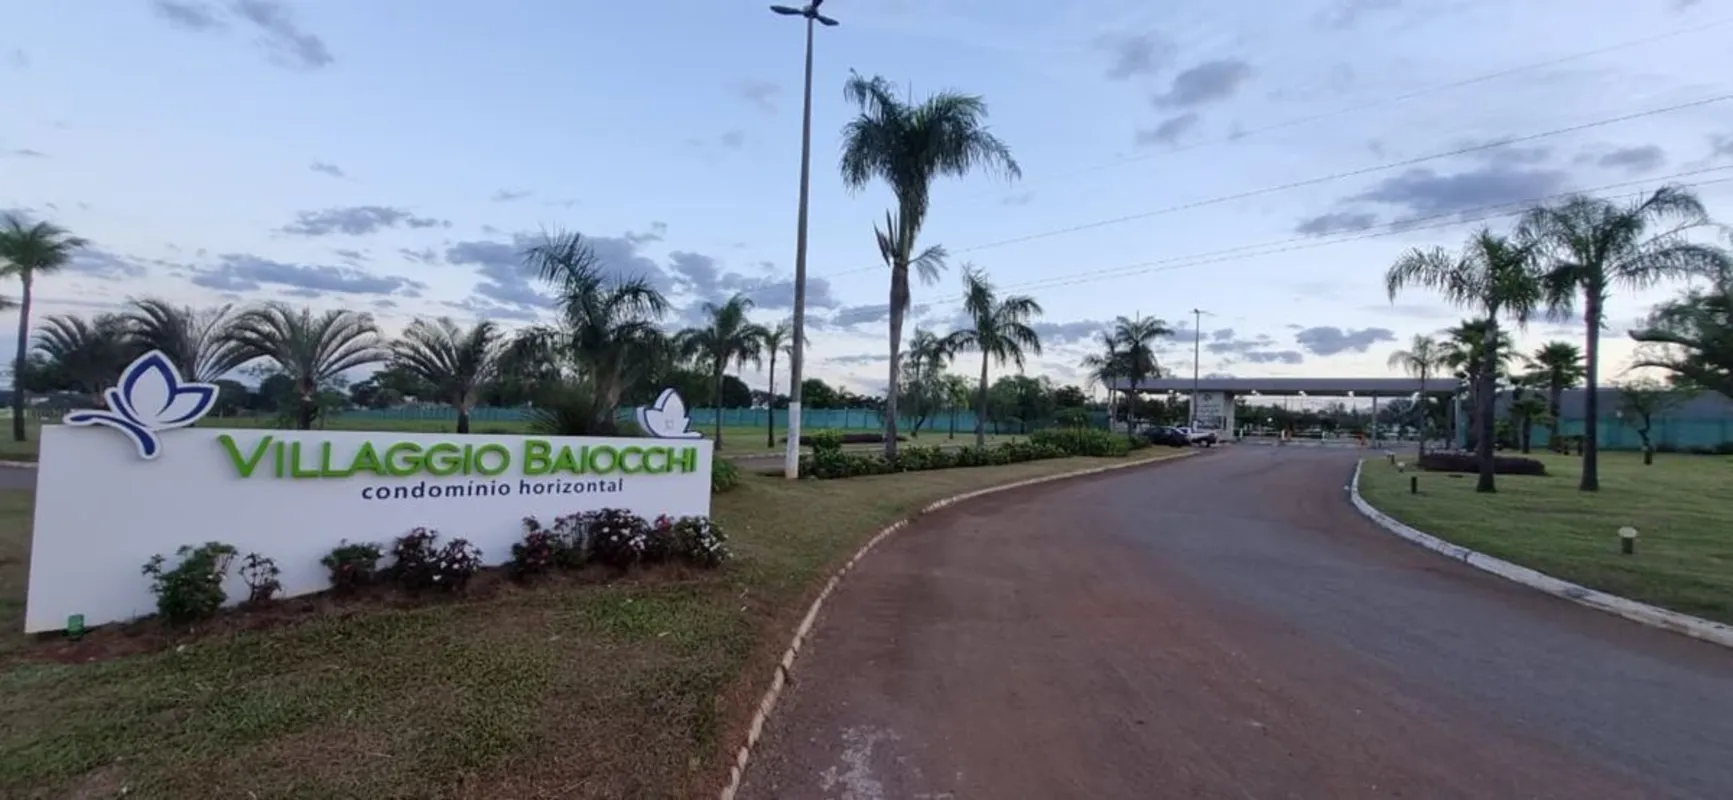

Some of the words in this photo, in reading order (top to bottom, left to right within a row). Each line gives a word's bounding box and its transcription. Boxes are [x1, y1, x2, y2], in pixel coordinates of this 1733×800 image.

[217, 434, 510, 479] VILLAGGIO
[523, 440, 697, 475] BAIOCCHI
[519, 478, 623, 495] horizontal
